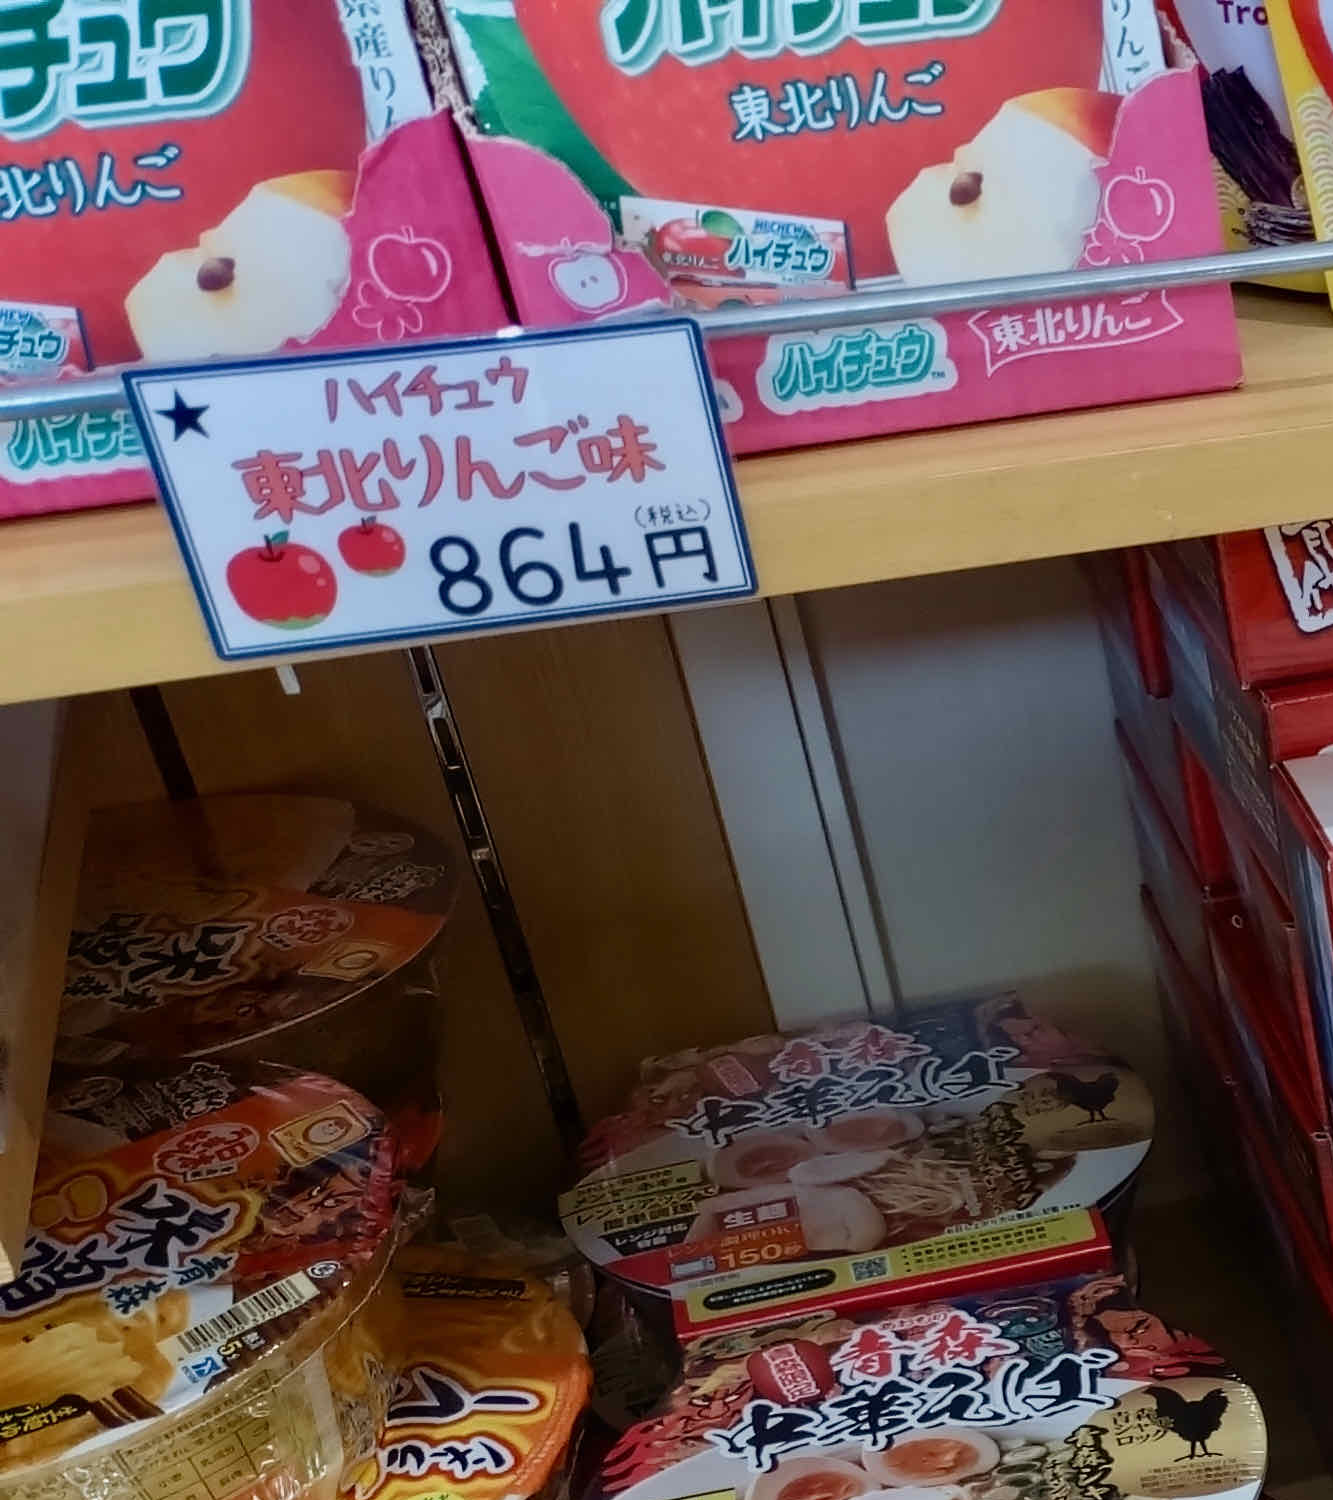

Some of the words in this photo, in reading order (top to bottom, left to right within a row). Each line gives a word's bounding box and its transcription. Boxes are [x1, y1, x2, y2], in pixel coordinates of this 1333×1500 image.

[730, 62, 945, 143] 東北りんご
[726, 237, 836, 279] ハイチュウ
[771, 325, 937, 401] ハイチュウ
[992, 297, 1153, 353] 東北りんご
[325, 356, 530, 422] ハイチュウ
[231, 414, 667, 525] 東北りんご味
[428, 521, 719, 617] 864円
[832, 1311, 1014, 1383] 青森
[706, 1349, 1118, 1471] 中華そば
